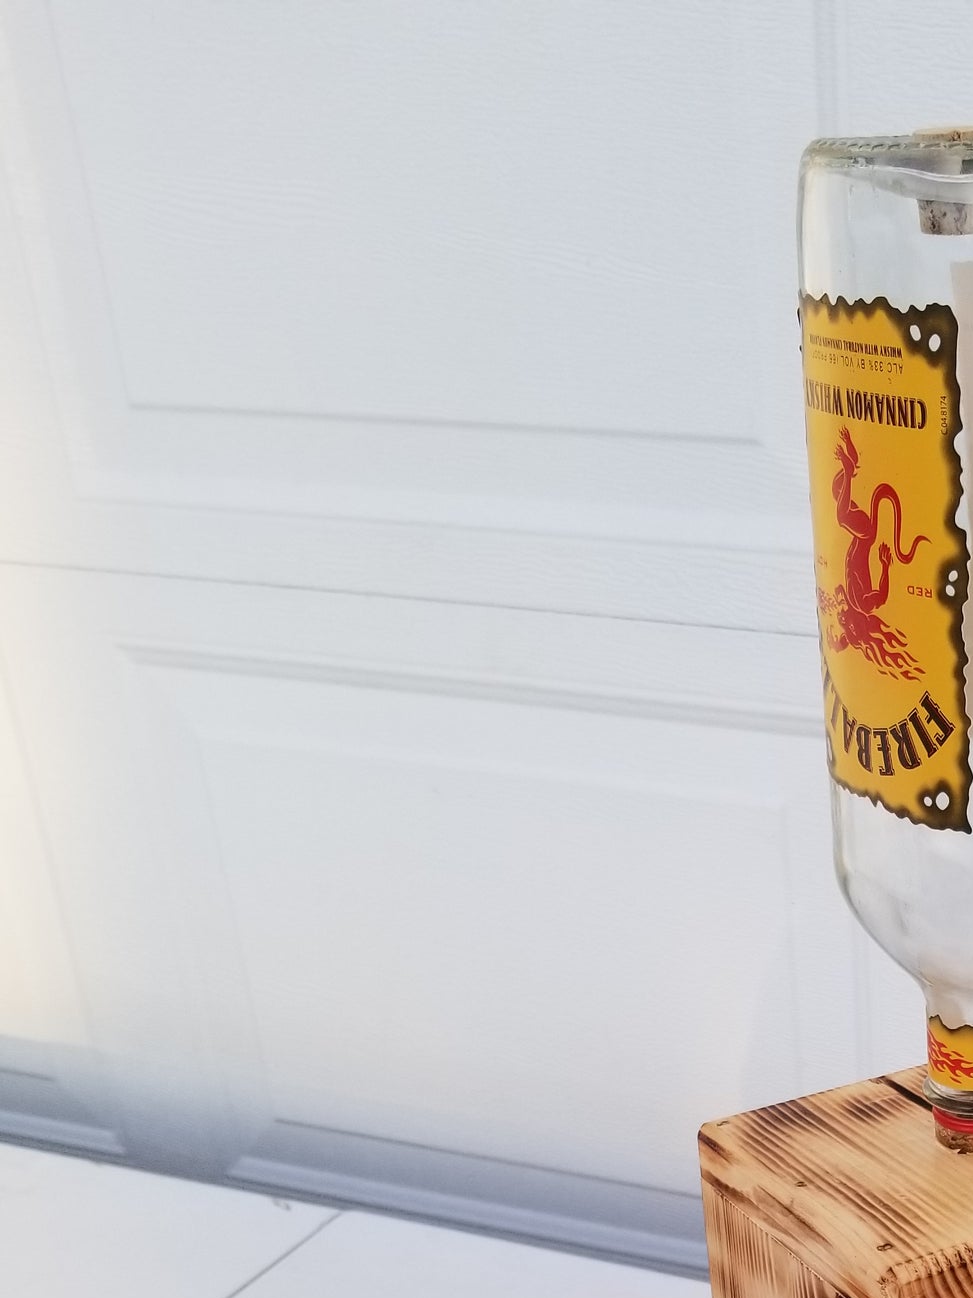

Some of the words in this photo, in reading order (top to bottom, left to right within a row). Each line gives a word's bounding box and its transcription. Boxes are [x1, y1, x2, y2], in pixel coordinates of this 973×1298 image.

[842, 340, 863, 355] NATURAL
[863, 343, 878, 356] WITH
[879, 345, 903, 359] WHISKY
[840, 355, 854, 367] VOL
[857, 357, 866, 369] BY
[868, 359, 884, 372] 33%
[886, 362, 903, 374] ALC
[846, 387, 928, 430] CINNAMON
[906, 584, 933, 598] RED
